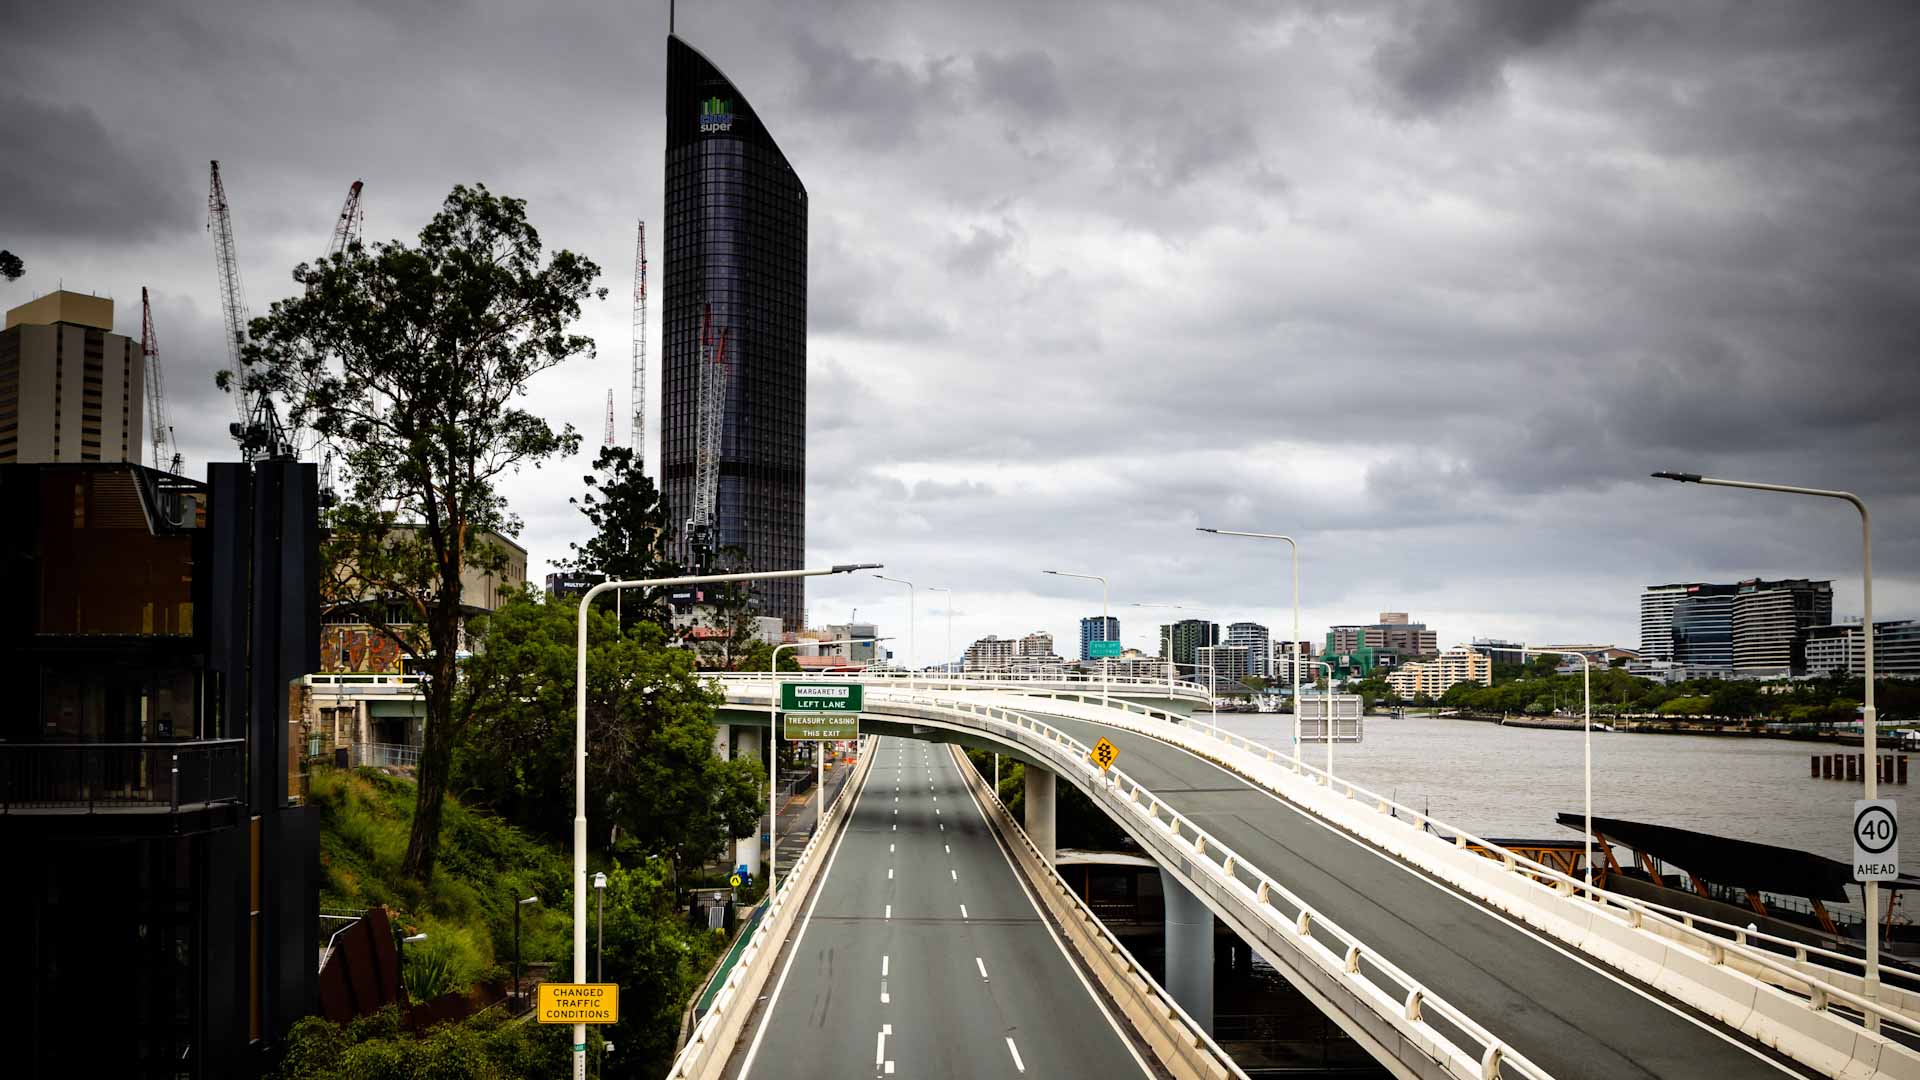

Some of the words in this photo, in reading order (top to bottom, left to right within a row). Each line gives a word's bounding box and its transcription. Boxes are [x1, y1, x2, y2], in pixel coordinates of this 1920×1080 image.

[700, 123, 733, 133] super
[1862, 820, 1890, 840] 40
[1857, 864, 1896, 875] AHEAD
[553, 988, 604, 997] CHANGED
[556, 999, 600, 1007] TRAFFIC
[546, 1010, 610, 1018] CONDITIONS
